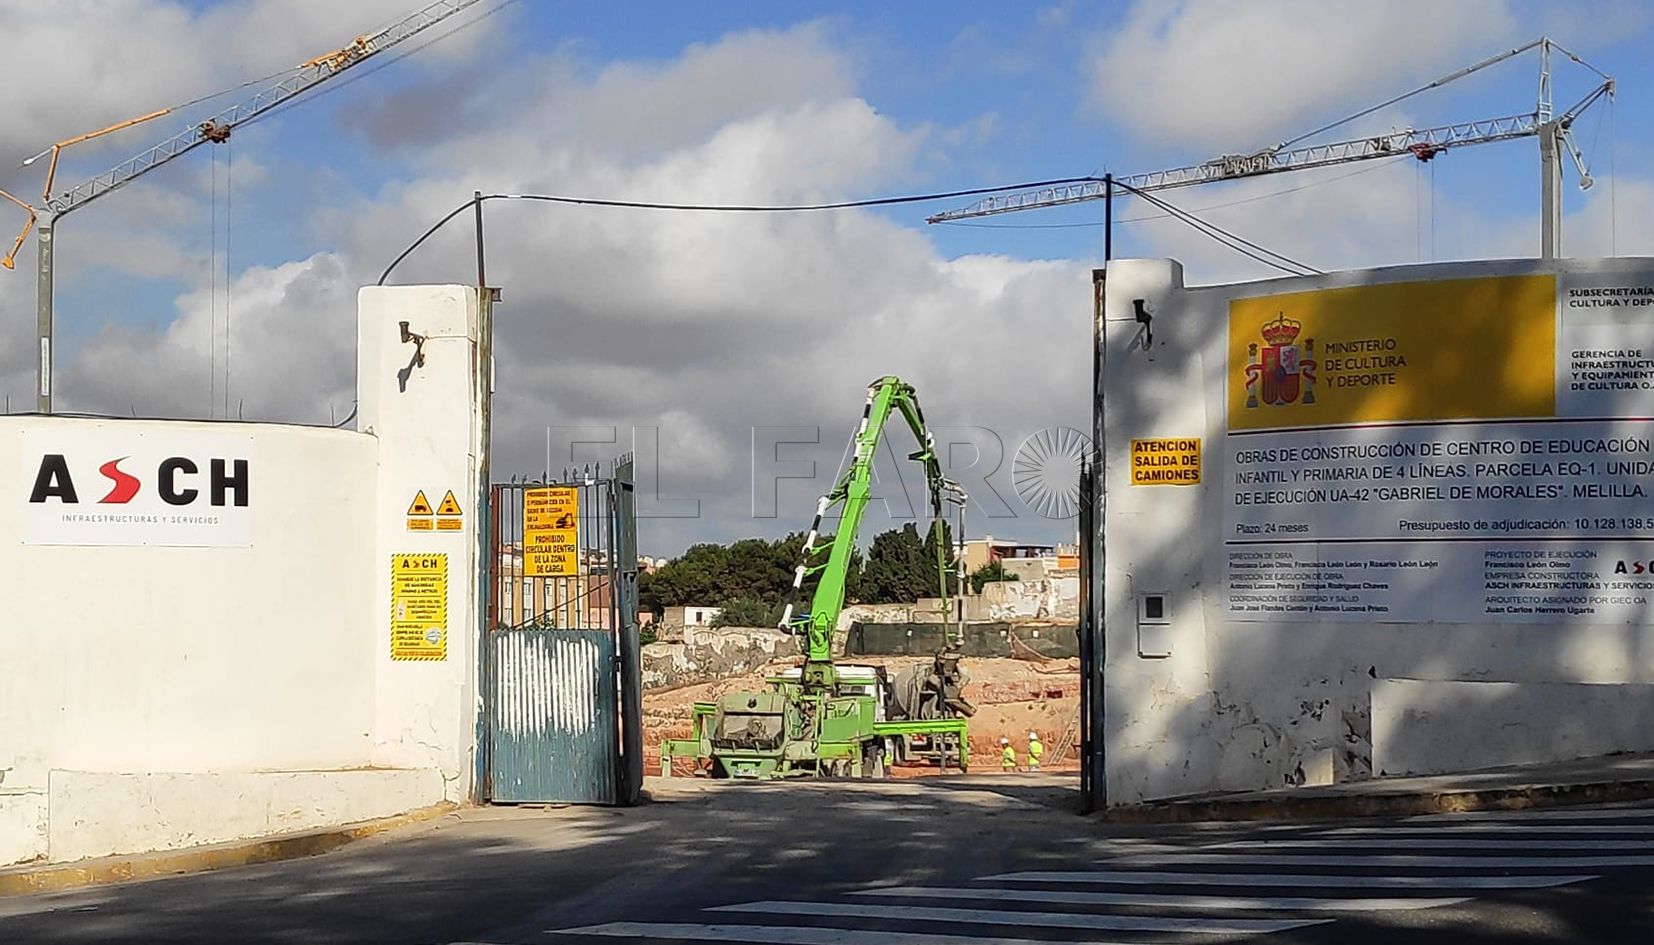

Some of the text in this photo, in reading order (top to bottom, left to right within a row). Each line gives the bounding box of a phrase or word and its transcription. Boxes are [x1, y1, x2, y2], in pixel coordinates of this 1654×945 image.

[1569, 299, 1620, 308] CULTURA
[1632, 298, 1654, 306] DEP
[1325, 338, 1396, 354] MINISTERIO
[1571, 350, 1642, 359] GERENCIA DE
[1325, 356, 1407, 372] DE CULTURA
[1326, 373, 1396, 388] Y DEPORTE
[1572, 372, 1579, 380] Y
[1571, 382, 1585, 390] DE
[1588, 382, 1639, 390] CULTURA
[1135, 441, 1197, 452] ATENCION
[1236, 436, 1649, 464] OBRAS DE CONSTRUCCIÓN DE CENTRO DE EDUCACIÓN
[1135, 455, 1198, 466] SALIDA DE
[1135, 469, 1199, 481] CAMIONES
[1236, 471, 1287, 484] INFANTIL
[1291, 470, 1299, 482] Y
[1303, 467, 1368, 482] PRIMARIA
[1372, 466, 1393, 479] DE
[1396, 466, 1405, 478] 4
[1410, 463, 1470, 478] LÍNEAS.
[1475, 463, 1553, 477] PARCELA
[1558, 462, 1600, 476] EQ-1.
[29, 454, 249, 507] ASCH
[1235, 492, 1251, 505] DE
[1254, 487, 1326, 504] EJECUCIÓN
[1330, 488, 1369, 502] UA-42
[1373, 487, 1444, 500] "GABRIEL
[1450, 486, 1472, 499] DE
[1573, 484, 1648, 498] MELILLA.
[62, 514, 219, 524] INFRAESTRUCTURAS Y SERVICIOS
[1236, 523, 1309, 534] Plazo: 24 meses
[1399, 519, 1470, 533] Presupuesto
[1473, 519, 1488, 530] de
[1491, 519, 1570, 532] adjudicación:
[535, 535, 565, 543] PROHIBIDO
[526, 545, 575, 554] CIRCULAR DENTRO
[1485, 551, 1532, 559] PROYECTO
[1548, 550, 1597, 558] EJECUCIÓN
[534, 555, 566, 563] DE LA ZONA
[1419, 560, 1439, 568] León
[1485, 560, 1571, 568] Francisco León Olmo
[536, 565, 564, 573] DE CARGA
[1567, 606, 1594, 614] Ugarte
